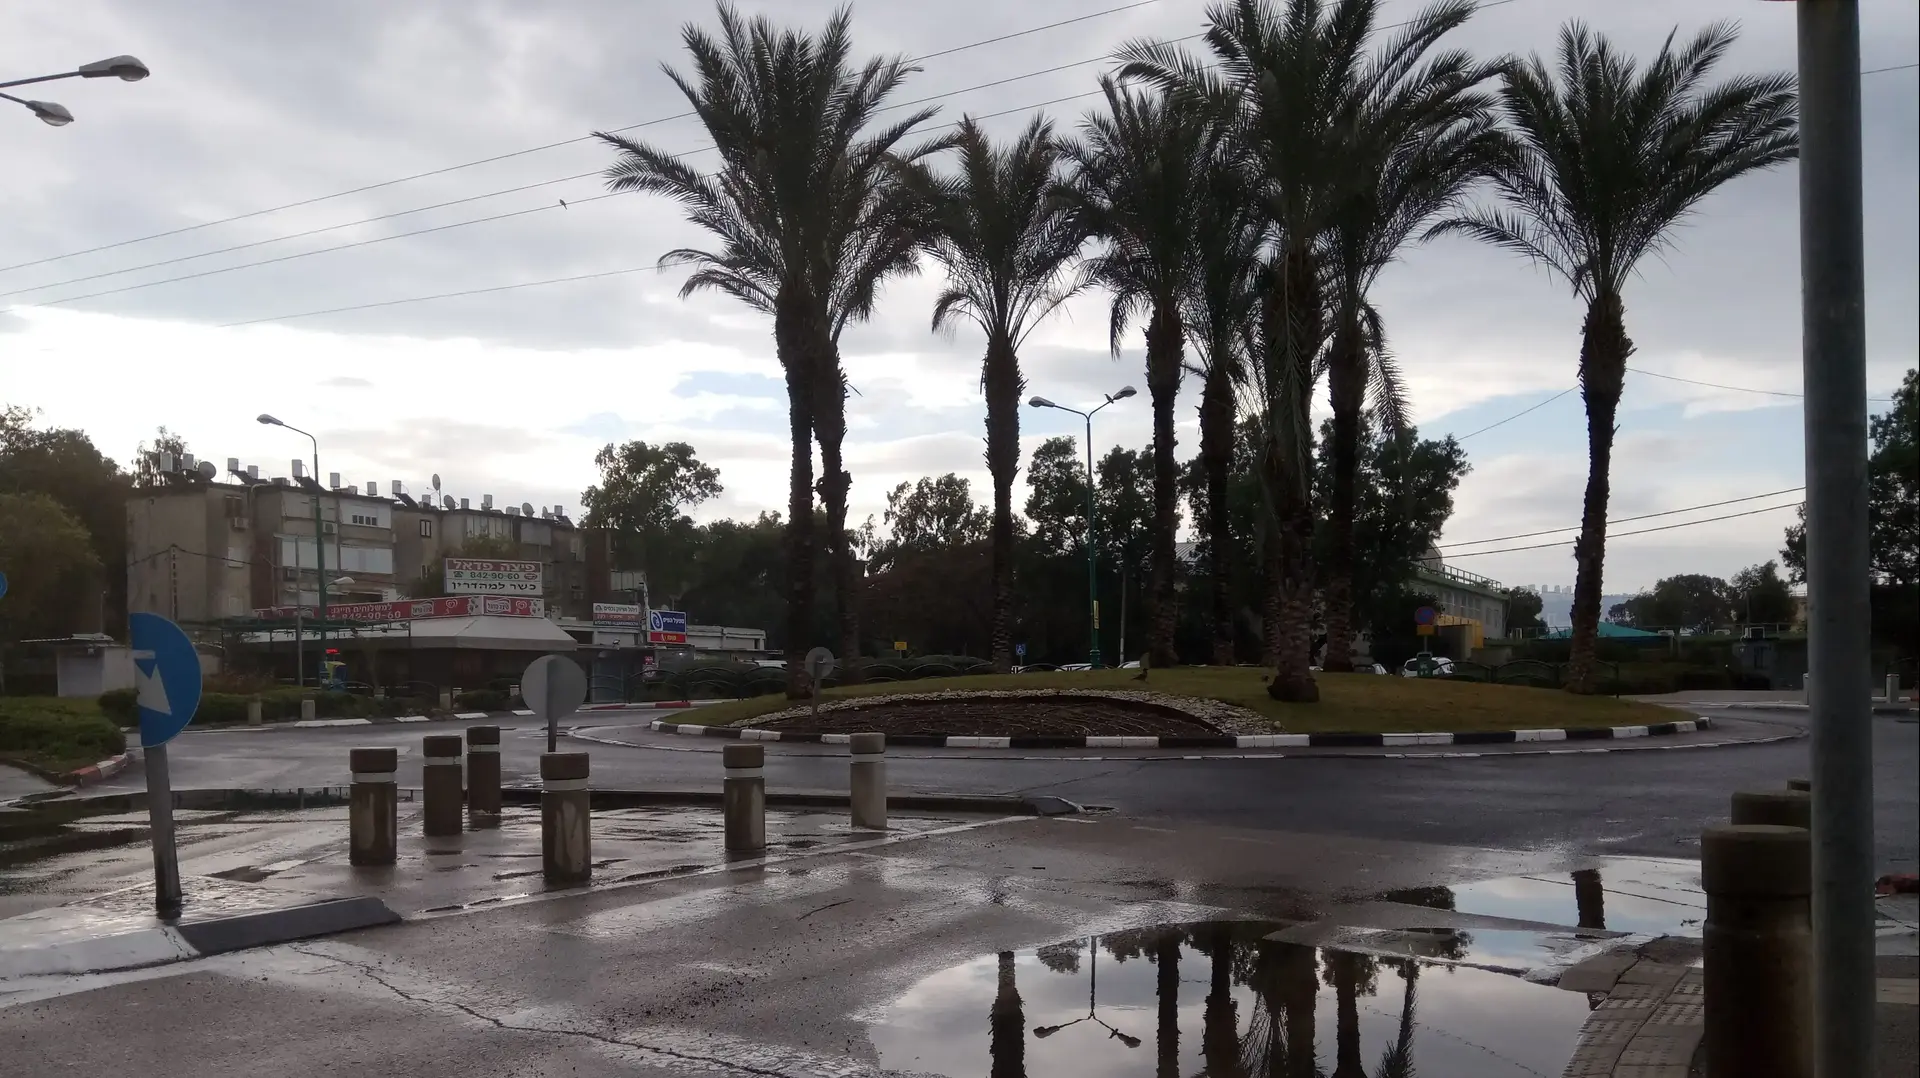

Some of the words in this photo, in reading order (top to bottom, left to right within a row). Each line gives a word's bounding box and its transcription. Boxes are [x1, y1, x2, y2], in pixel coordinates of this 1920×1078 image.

[453, 560, 493, 571] פדאל
[500, 563, 536, 572] פיצה
[470, 571, 520, 580] 842-90-60
[452, 581, 505, 590] למהדרין
[353, 602, 392, 613] למשלוחים
